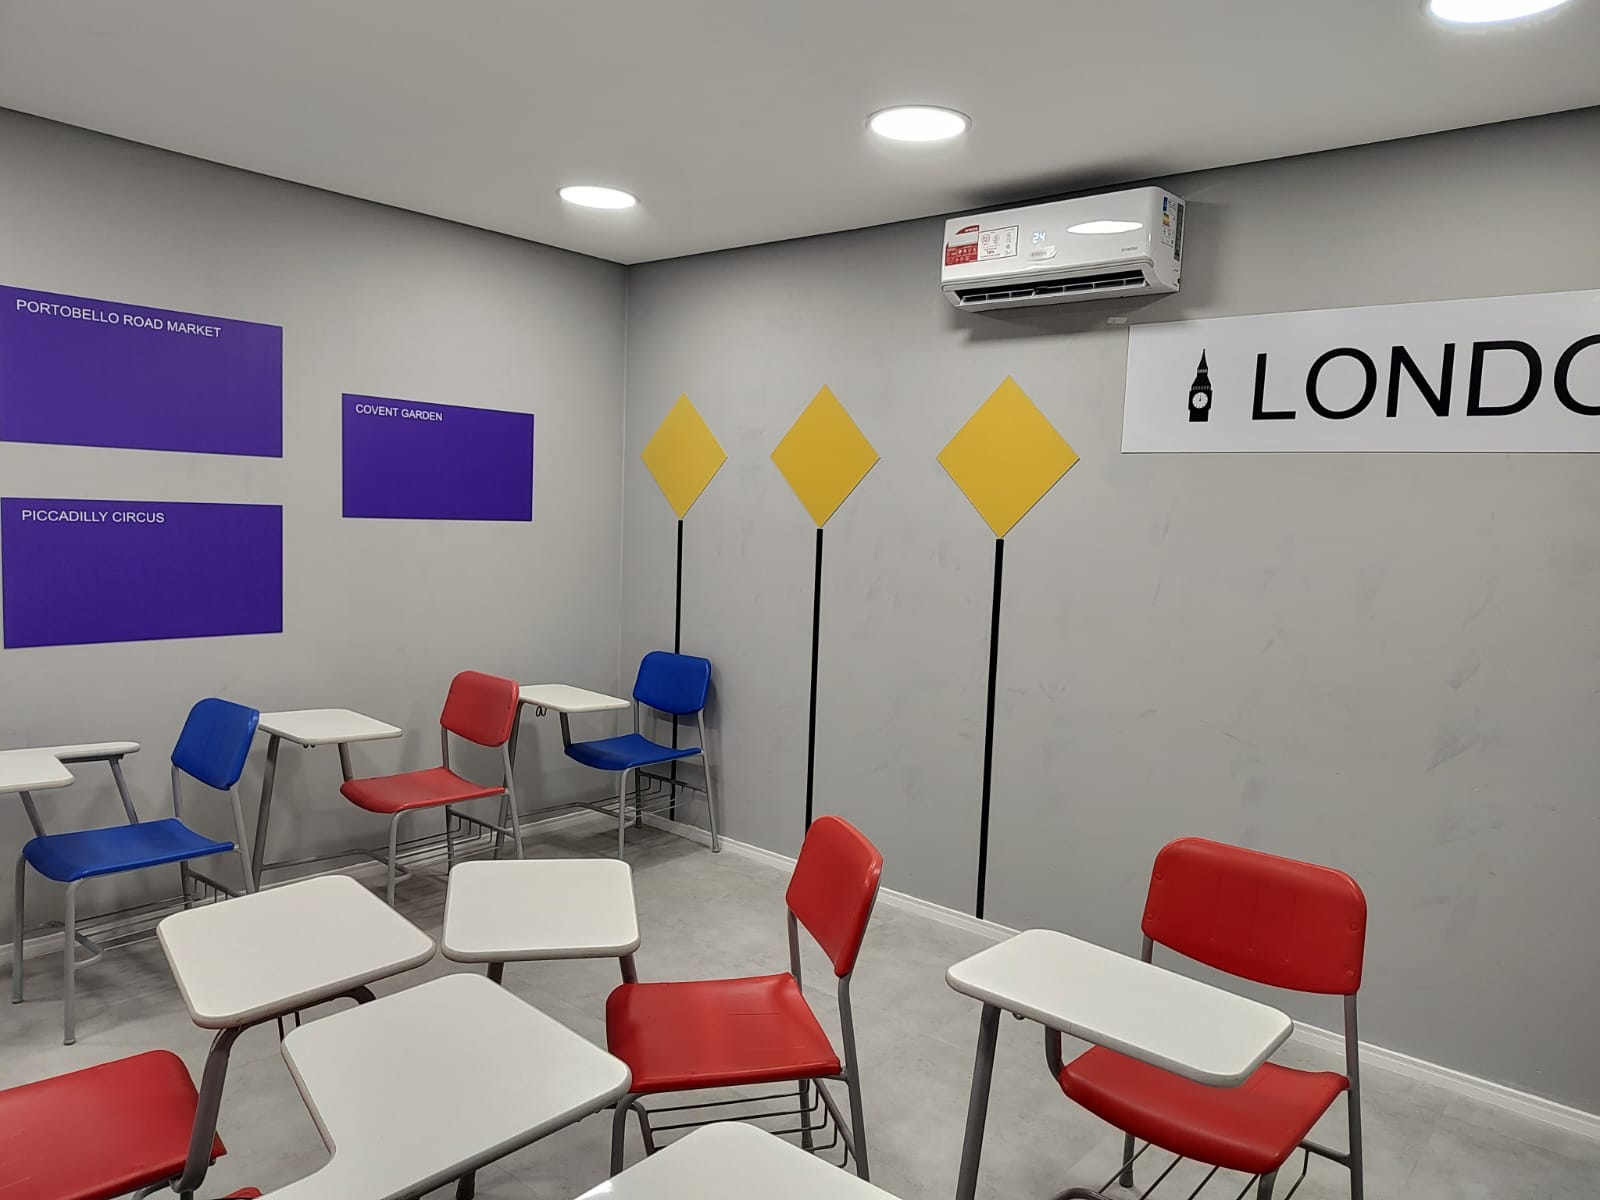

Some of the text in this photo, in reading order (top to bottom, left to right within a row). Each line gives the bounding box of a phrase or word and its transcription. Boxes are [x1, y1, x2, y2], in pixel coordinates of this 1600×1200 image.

[1032, 231, 1046, 244] 24
[16, 298, 222, 338] PORTOBELLO ROAD MARKET
[1252, 333, 1600, 420] LONDO
[355, 403, 443, 422] COVENT GARDEN
[21, 509, 165, 523] PICCADILLY CIRCUS
